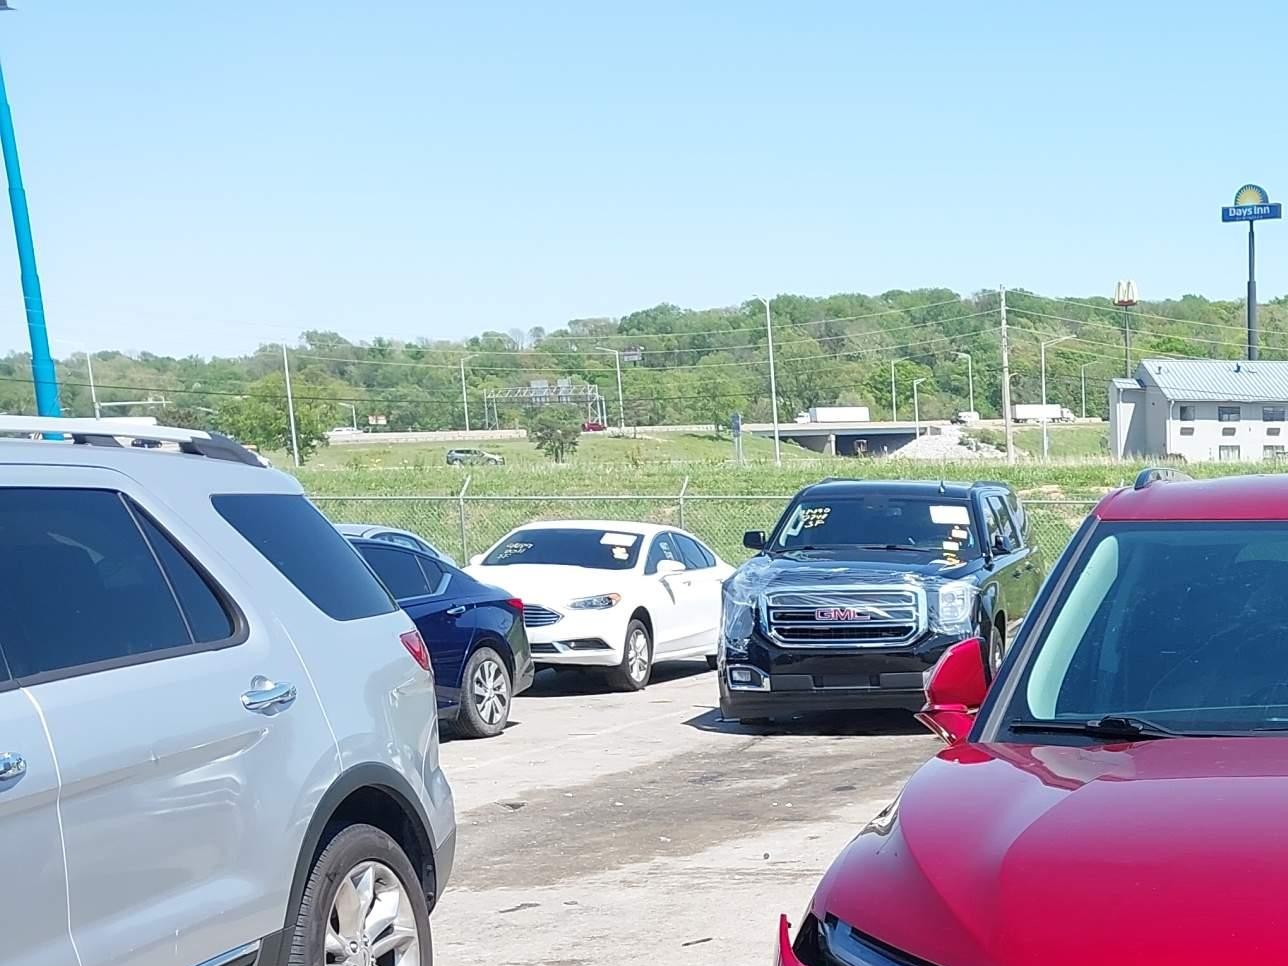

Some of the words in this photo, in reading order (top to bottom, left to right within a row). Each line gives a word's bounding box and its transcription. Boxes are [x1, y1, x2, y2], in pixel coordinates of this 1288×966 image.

[1228, 207, 1253, 218] Days
[1253, 205, 1270, 215] Inn
[815, 607, 871, 620] GMC
